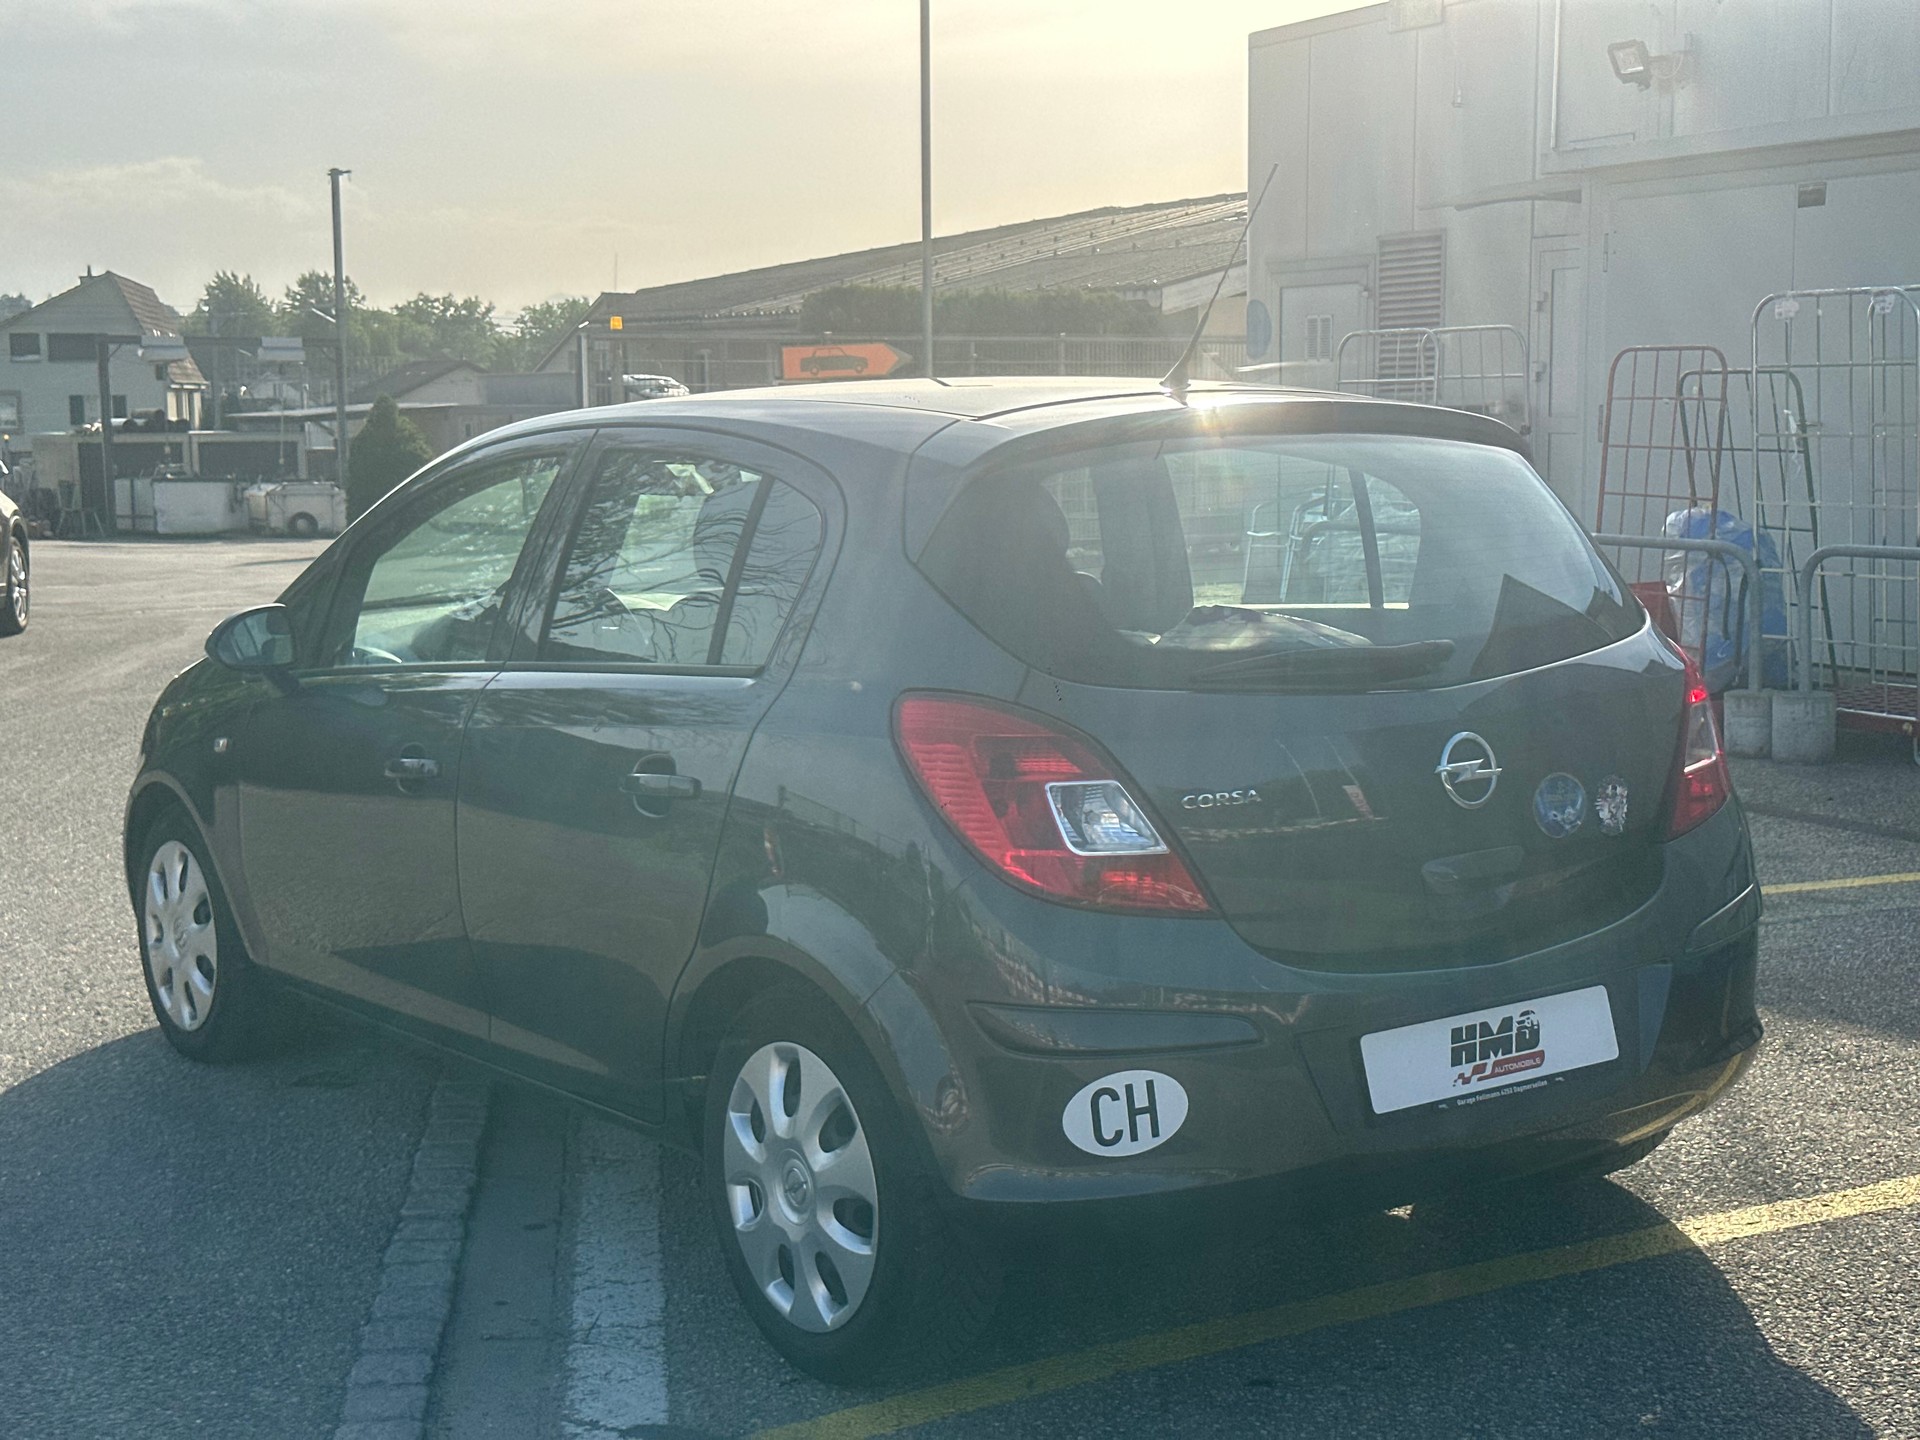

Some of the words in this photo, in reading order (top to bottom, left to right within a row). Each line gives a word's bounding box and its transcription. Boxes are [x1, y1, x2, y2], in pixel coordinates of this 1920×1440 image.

[1181, 789, 1262, 809] CORSA
[1494, 1057, 1541, 1073] AUTOMOBILE
[1457, 1097, 1476, 1105] Garage
[1091, 1079, 1160, 1147] CH
